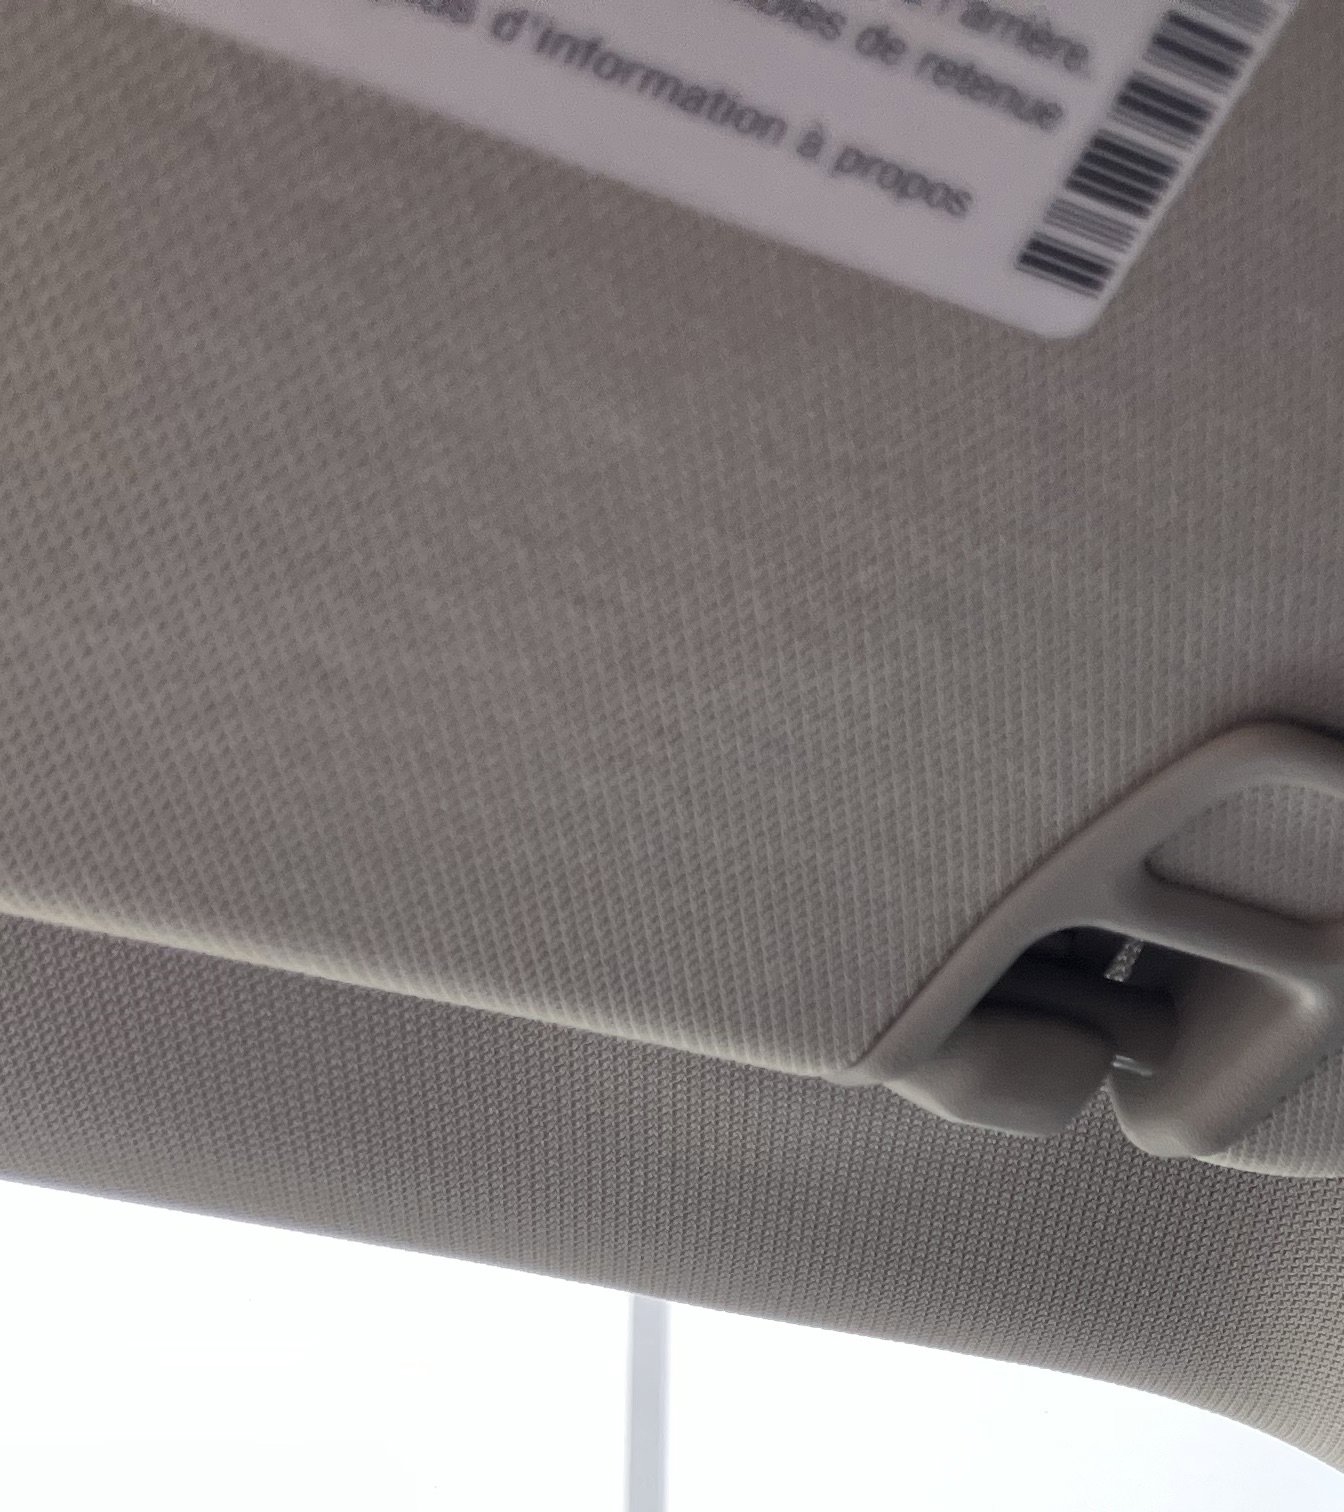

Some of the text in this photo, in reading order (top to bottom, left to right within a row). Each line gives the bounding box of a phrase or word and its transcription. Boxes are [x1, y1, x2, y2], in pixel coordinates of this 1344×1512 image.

[855, 25, 907, 66] de
[491, 9, 788, 144] d'information
[798, 121, 827, 159] à
[826, 145, 974, 217] propos
